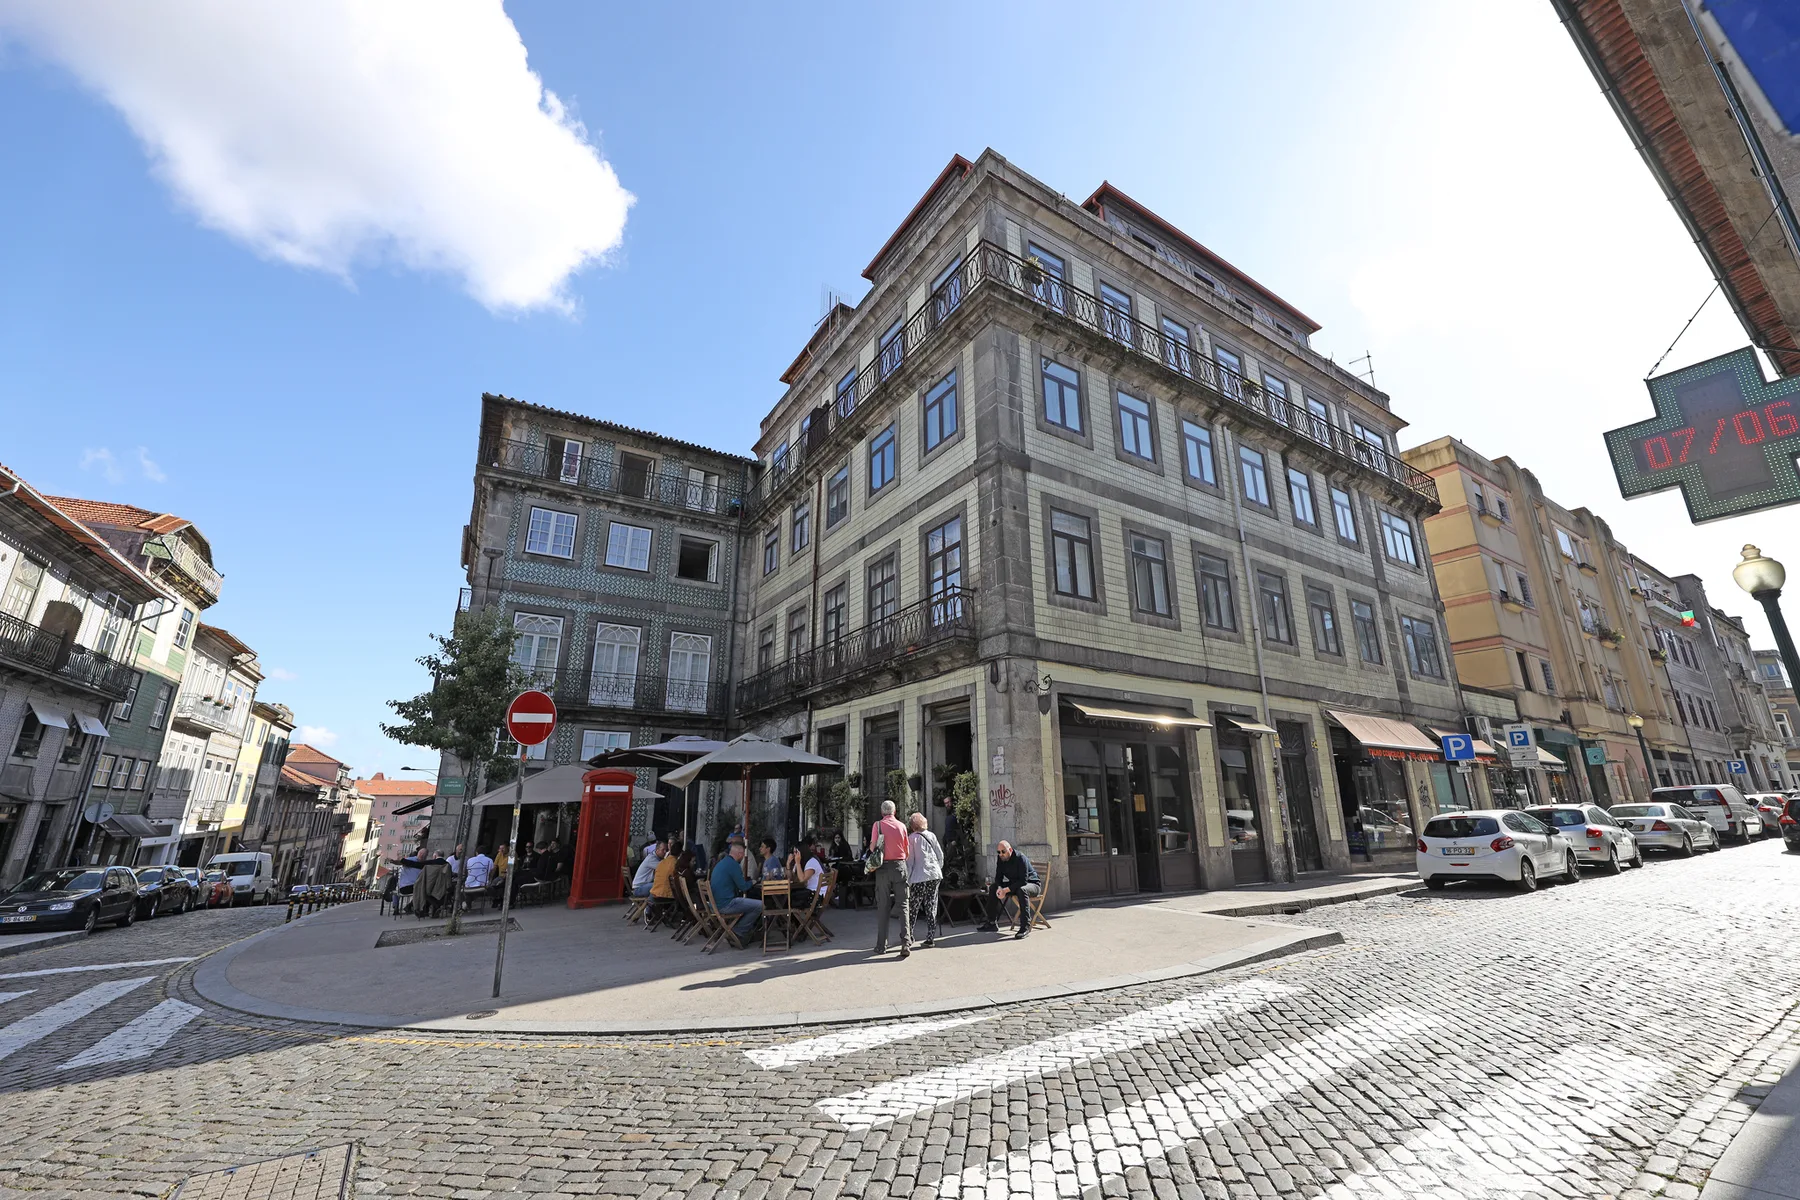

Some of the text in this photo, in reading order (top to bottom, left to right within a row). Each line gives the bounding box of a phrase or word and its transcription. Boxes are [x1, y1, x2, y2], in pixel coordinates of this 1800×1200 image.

[1644, 400, 1799, 469] 07/06
[1513, 733, 1524, 744] P
[1449, 738, 1465, 757] P
[1730, 761, 1741, 773] P
